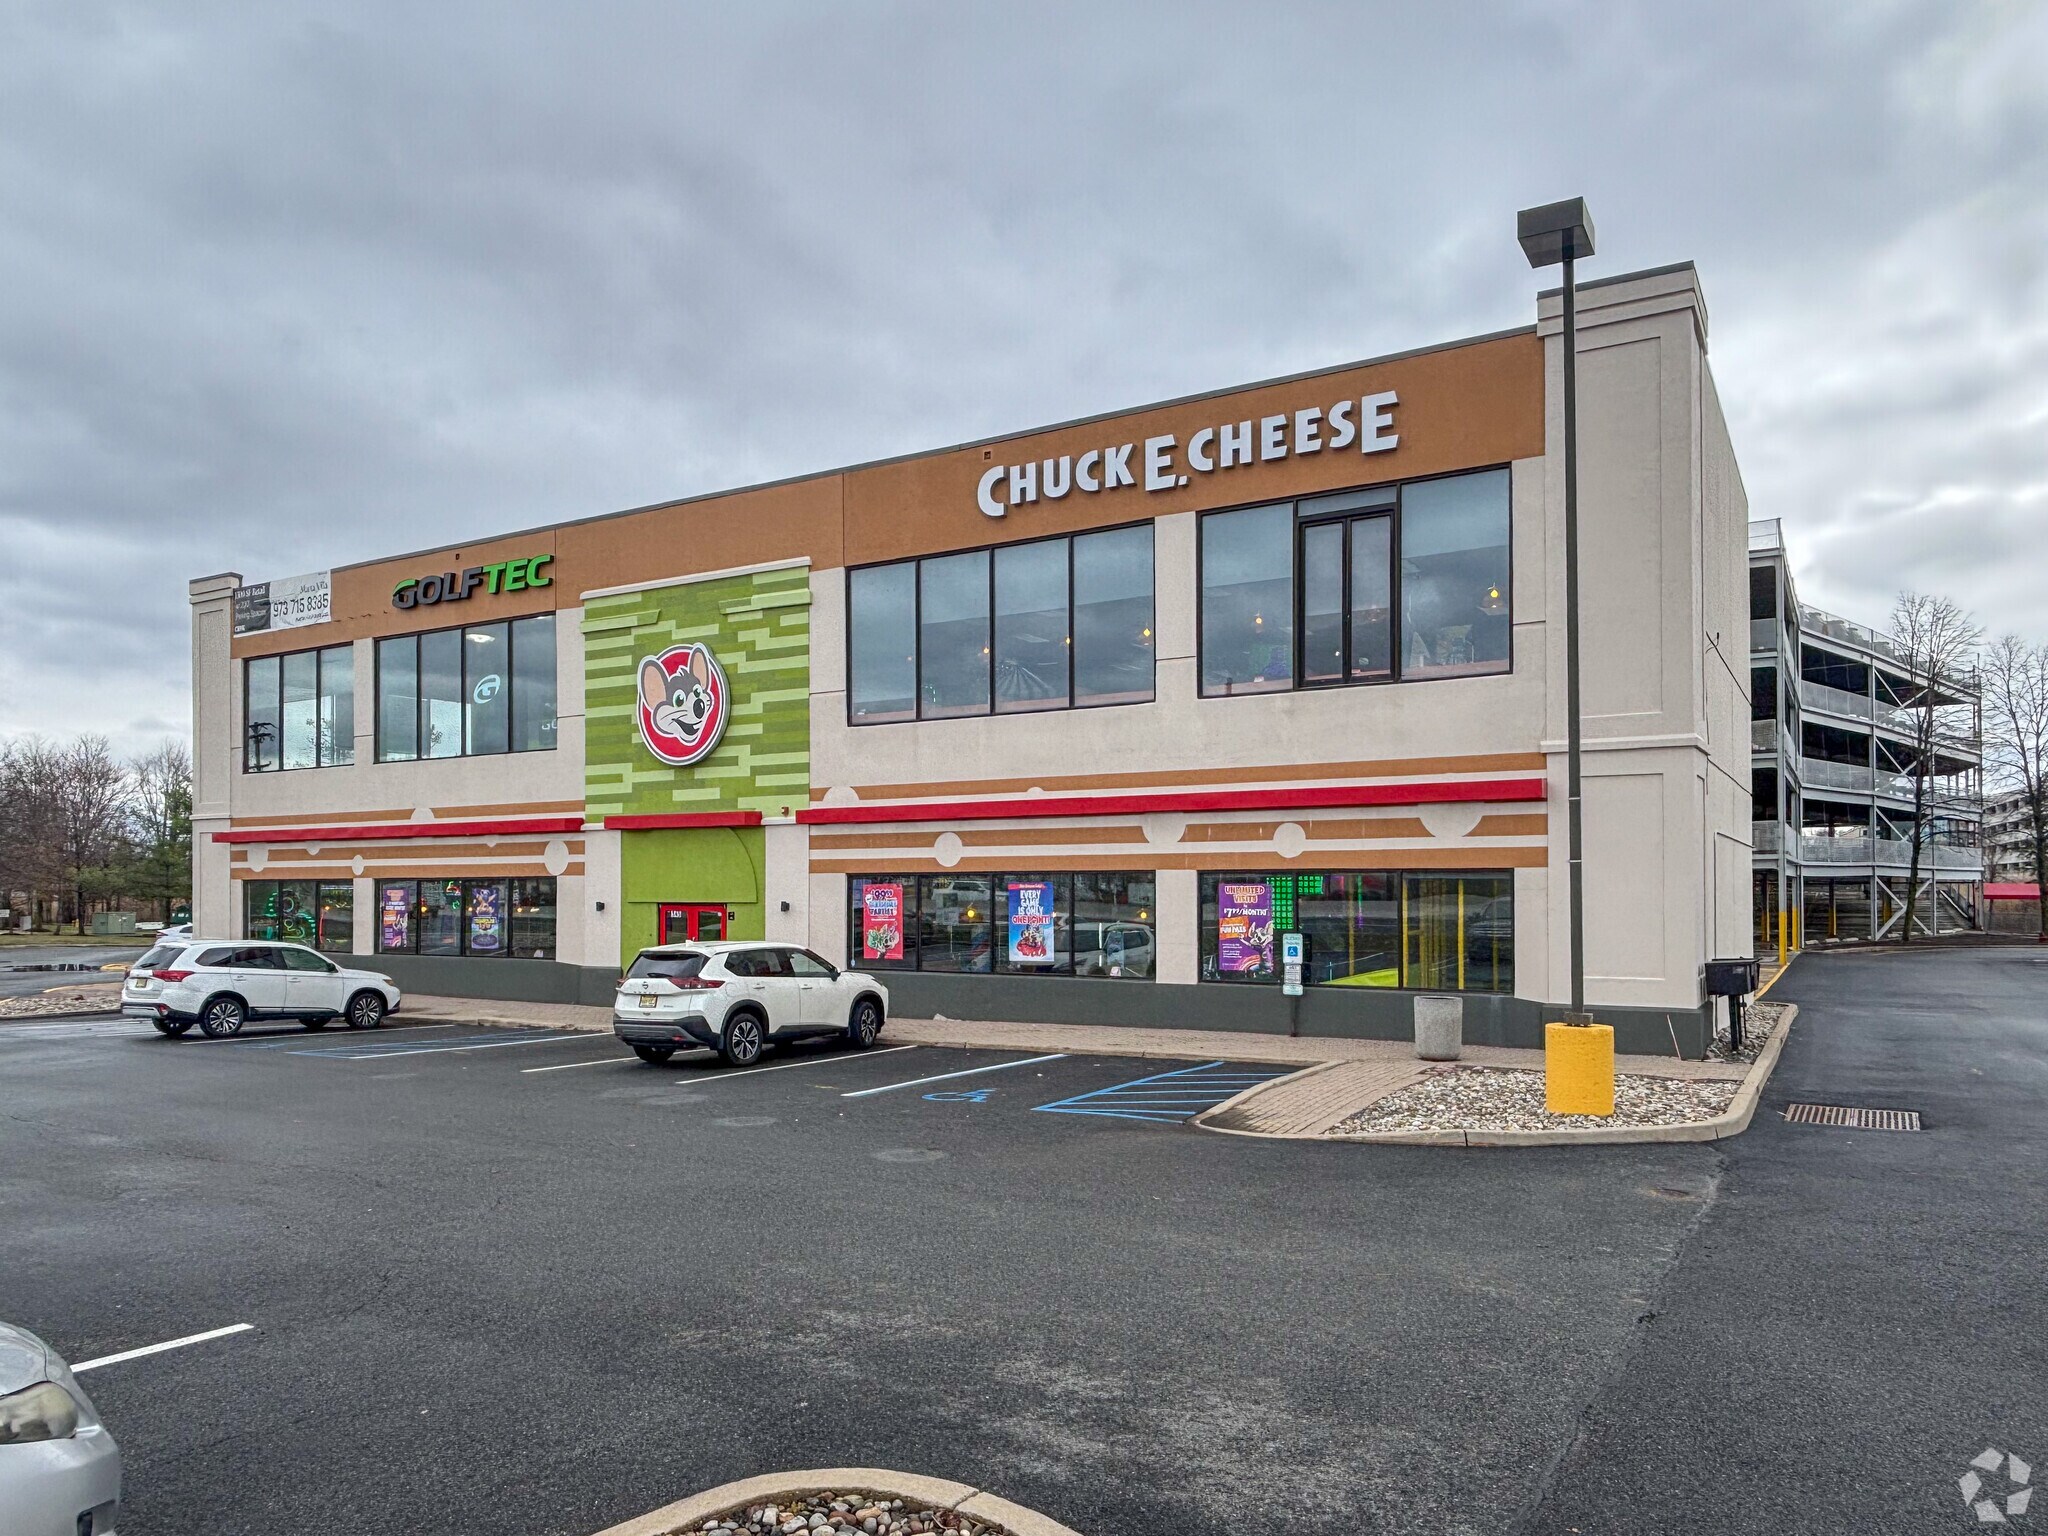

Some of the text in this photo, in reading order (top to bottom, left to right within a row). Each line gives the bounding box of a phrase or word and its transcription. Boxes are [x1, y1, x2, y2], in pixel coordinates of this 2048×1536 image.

[976, 390, 1400, 518] CHUCK E. CHEESE
[392, 554, 554, 609] GOLFTEC
[273, 600, 288, 617] 973
[290, 597, 304, 614] 715
[1020, 889, 1041, 899] EVERY
[1026, 905, 1044, 916] ONLY
